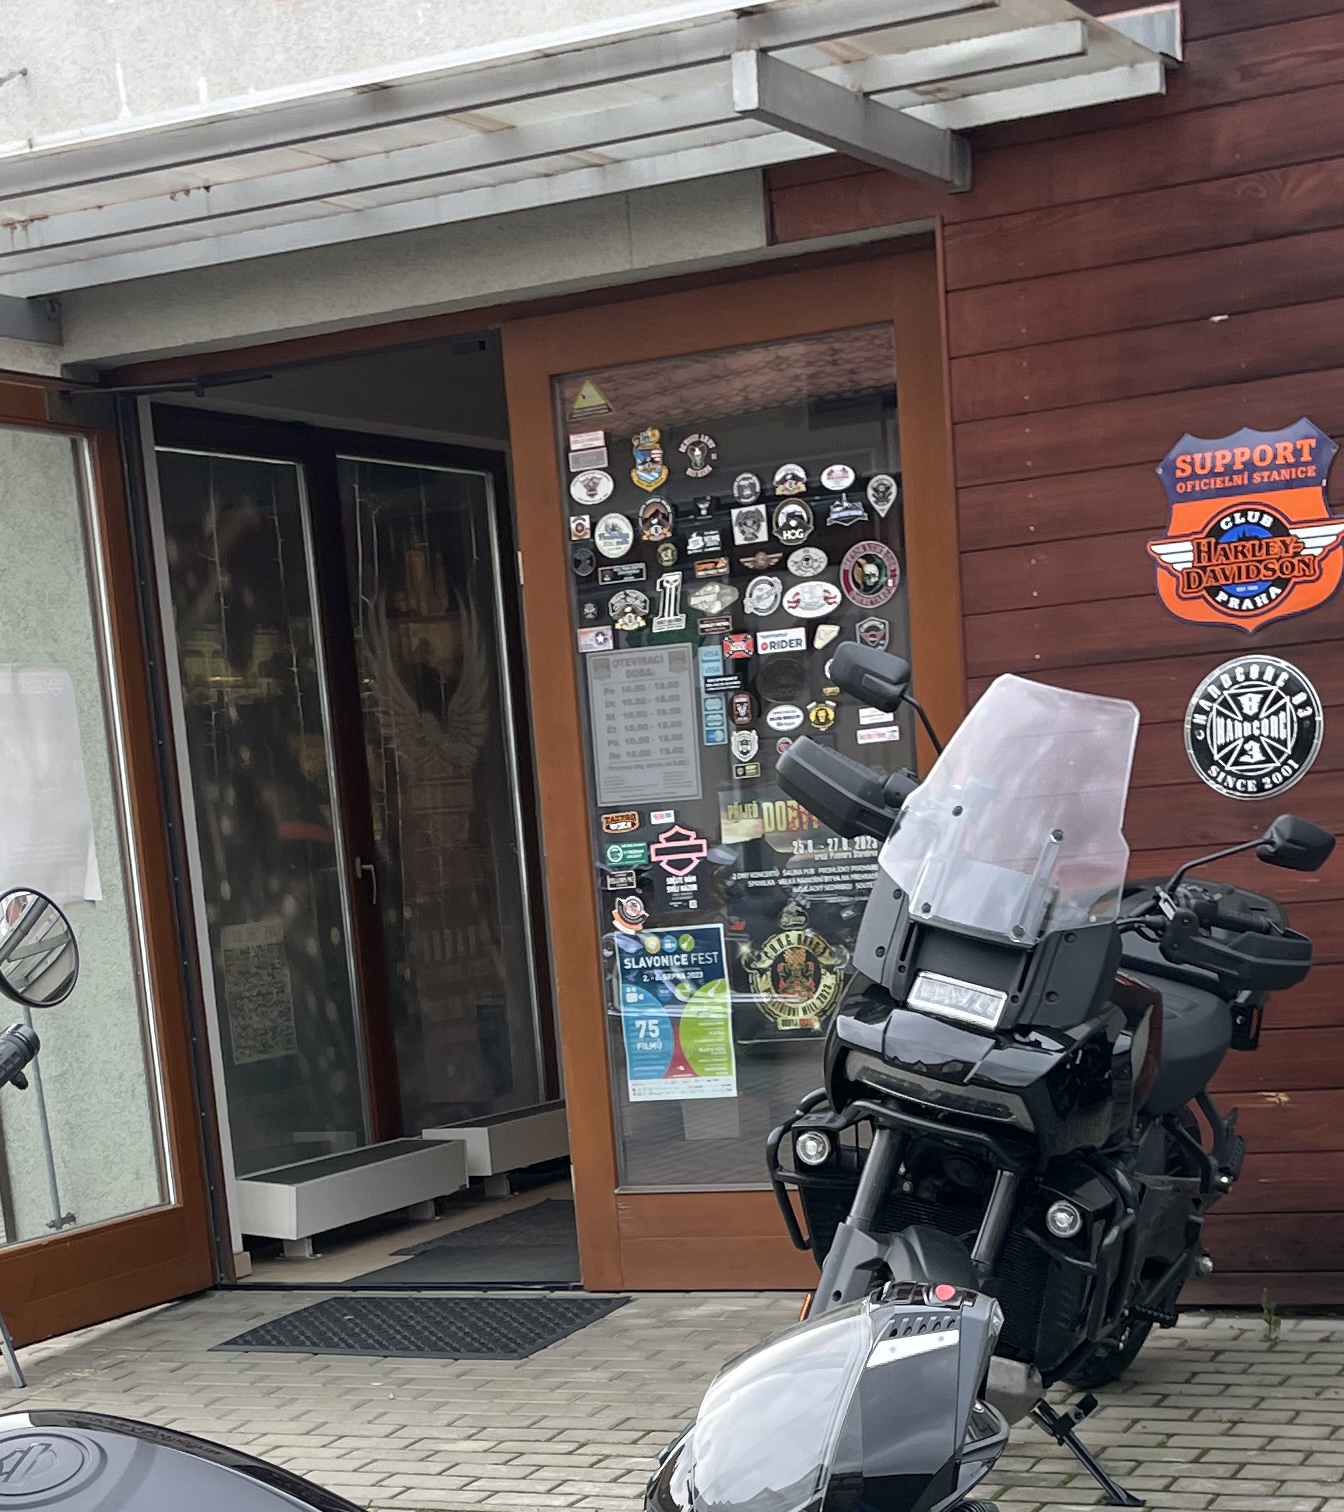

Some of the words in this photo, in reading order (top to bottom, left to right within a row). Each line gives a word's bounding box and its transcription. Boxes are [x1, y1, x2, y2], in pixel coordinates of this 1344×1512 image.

[1175, 438, 1317, 478] SUPPORT
[1176, 472, 1249, 493] OFICIELNÍ
[1252, 464, 1317, 484] STANICE
[1219, 510, 1274, 531] CLUB
[782, 529, 805, 541] HOG
[1192, 535, 1306, 565] HARLEY-
[1182, 554, 1316, 594] DAVIDSON
[1214, 586, 1283, 612] PRAHA
[768, 638, 803, 652] RIDER
[1192, 664, 1290, 725] HARDCORE
[1216, 710, 1288, 745] HARDCORE
[1208, 764, 1258, 793] SINCE
[1261, 760, 1299, 789] 2001
[623, 955, 689, 969] SLAVONICE
[690, 951, 719, 966] FEST
[635, 1019, 660, 1039] 75
[636, 1037, 664, 1052] FILMŮ
